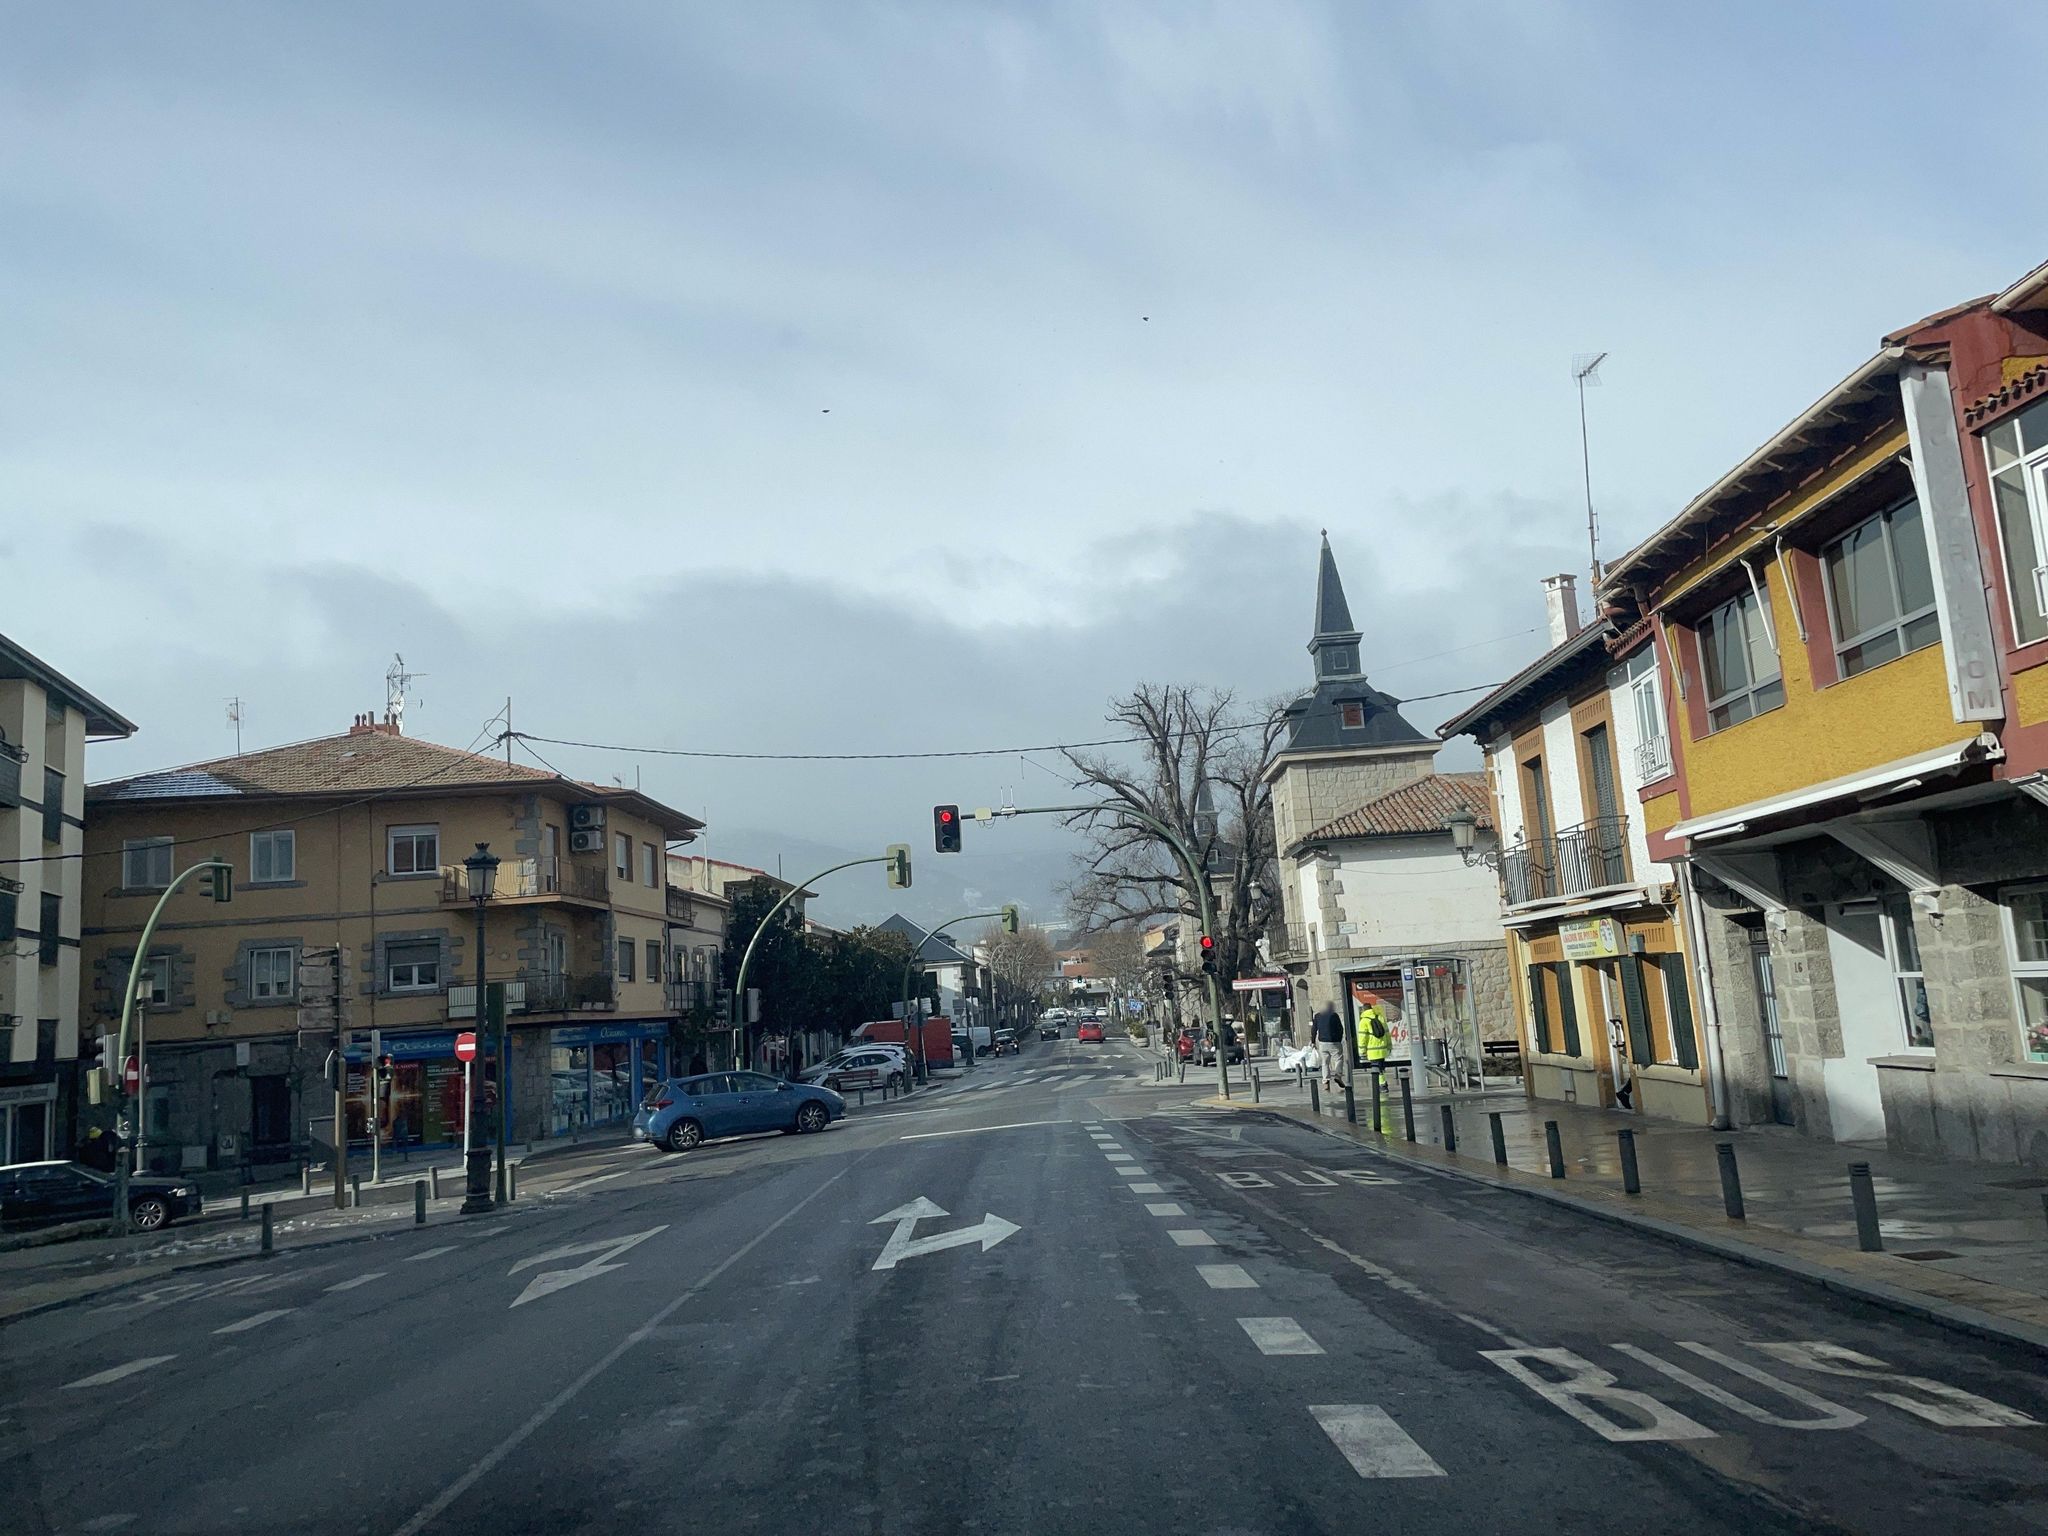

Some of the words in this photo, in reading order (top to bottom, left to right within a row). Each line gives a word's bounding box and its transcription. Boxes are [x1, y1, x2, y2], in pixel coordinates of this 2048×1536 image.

[1794, 962, 1803, 973] 16
[1215, 1169, 1403, 1188] BUS
[1477, 1340, 2044, 1441] BUS
